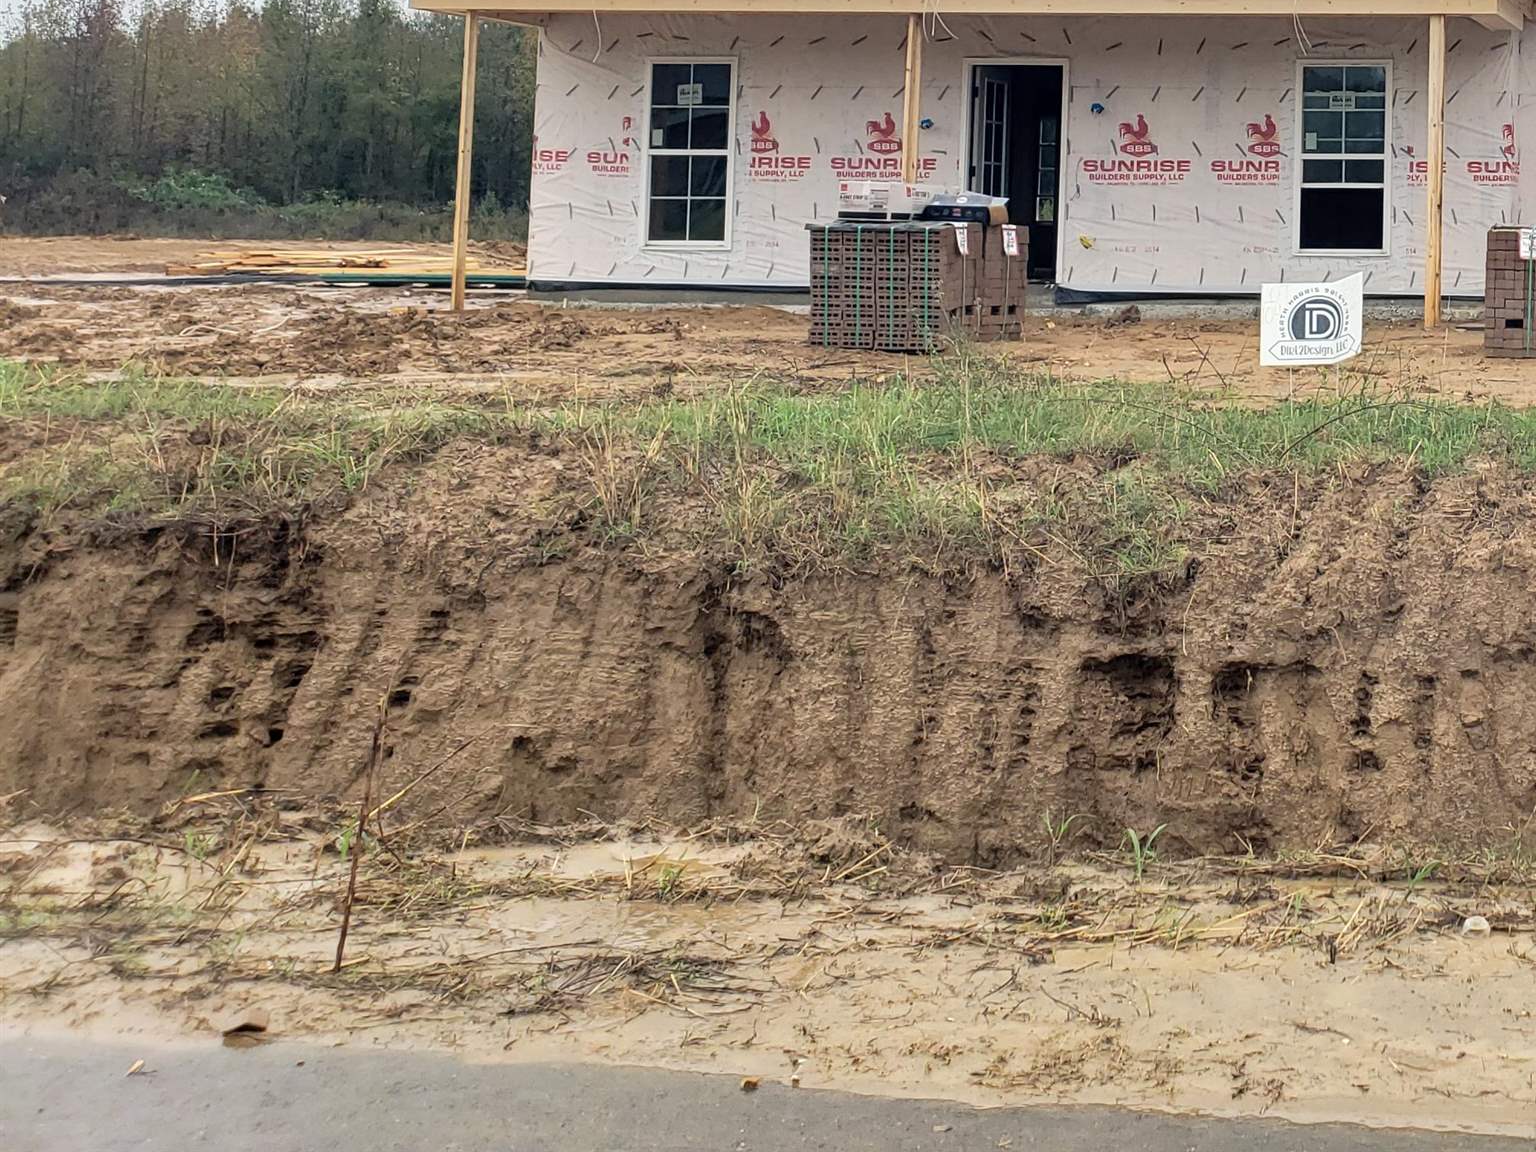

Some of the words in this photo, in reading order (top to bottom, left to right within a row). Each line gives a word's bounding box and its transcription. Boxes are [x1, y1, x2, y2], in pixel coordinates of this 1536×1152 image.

[873, 142, 898, 150] SBS
[1127, 145, 1151, 153] SBS
[547, 163, 562, 171] LLC
[1083, 160, 1191, 173] SUNRISE
[754, 170, 788, 179] SUPPLY,
[789, 170, 805, 178] LLC
[836, 171, 877, 179] BUILDERS
[1089, 173, 1131, 181] BUILDERS
[1132, 173, 1167, 182] SUPPLY,
[1169, 173, 1184, 181] LLC
[1217, 173, 1258, 181] BUILDERS
